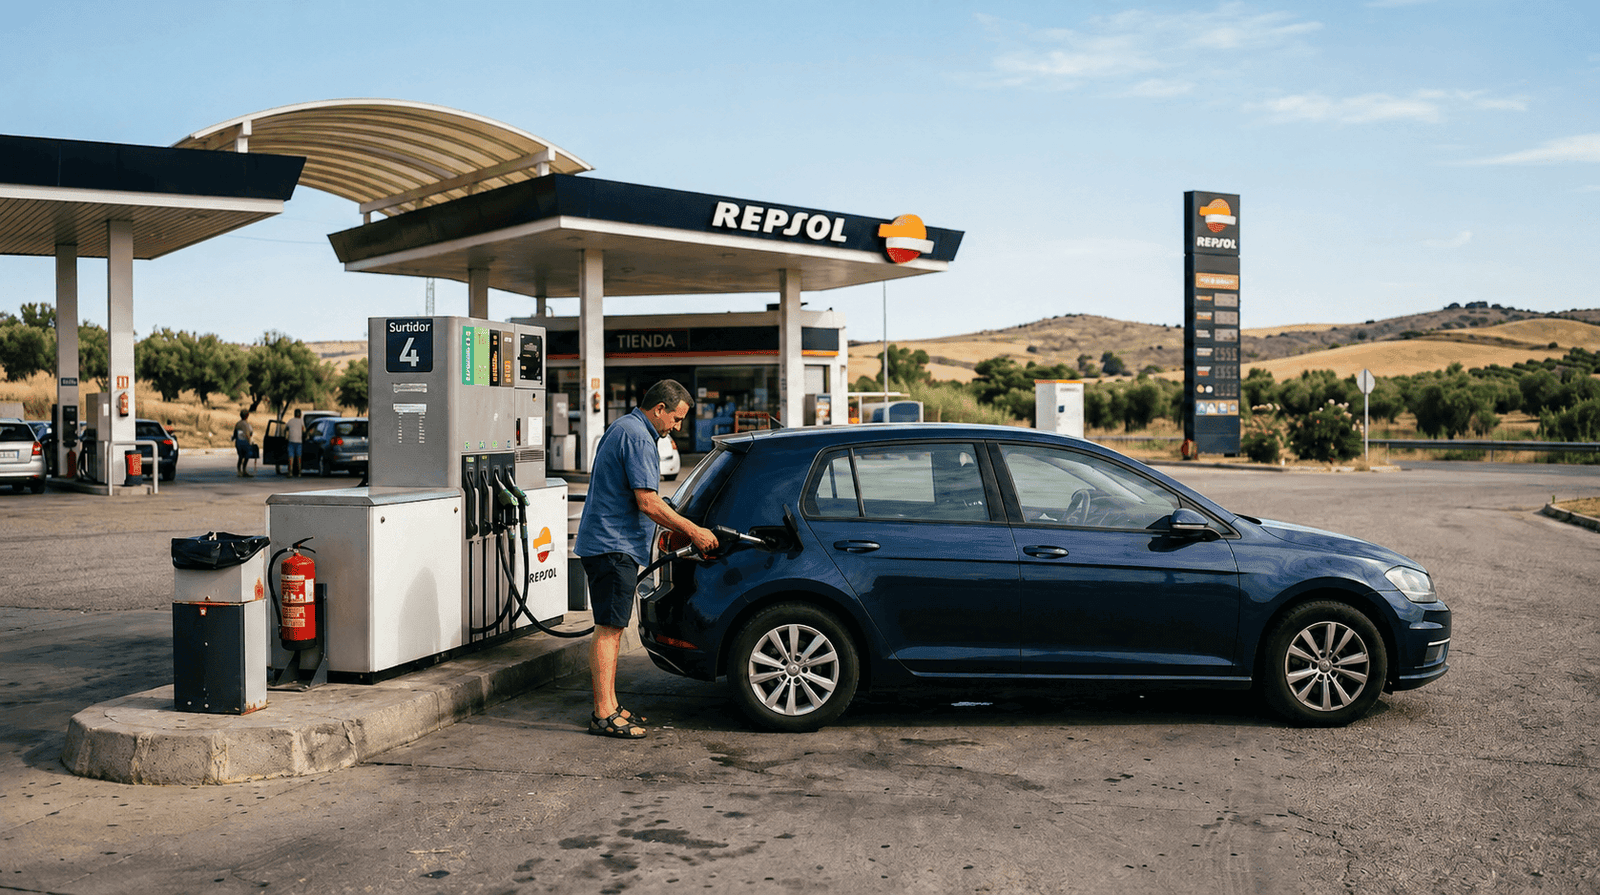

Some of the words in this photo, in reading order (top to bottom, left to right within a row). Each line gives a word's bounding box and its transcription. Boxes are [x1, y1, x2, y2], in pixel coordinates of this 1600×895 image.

[711, 201, 848, 243] REPSOL
[1196, 236, 1237, 250] REPSOL
[389, 321, 431, 334] Surtidor
[617, 334, 676, 349] TIENDA
[399, 337, 420, 367] 4
[529, 568, 557, 584] REPSOL
